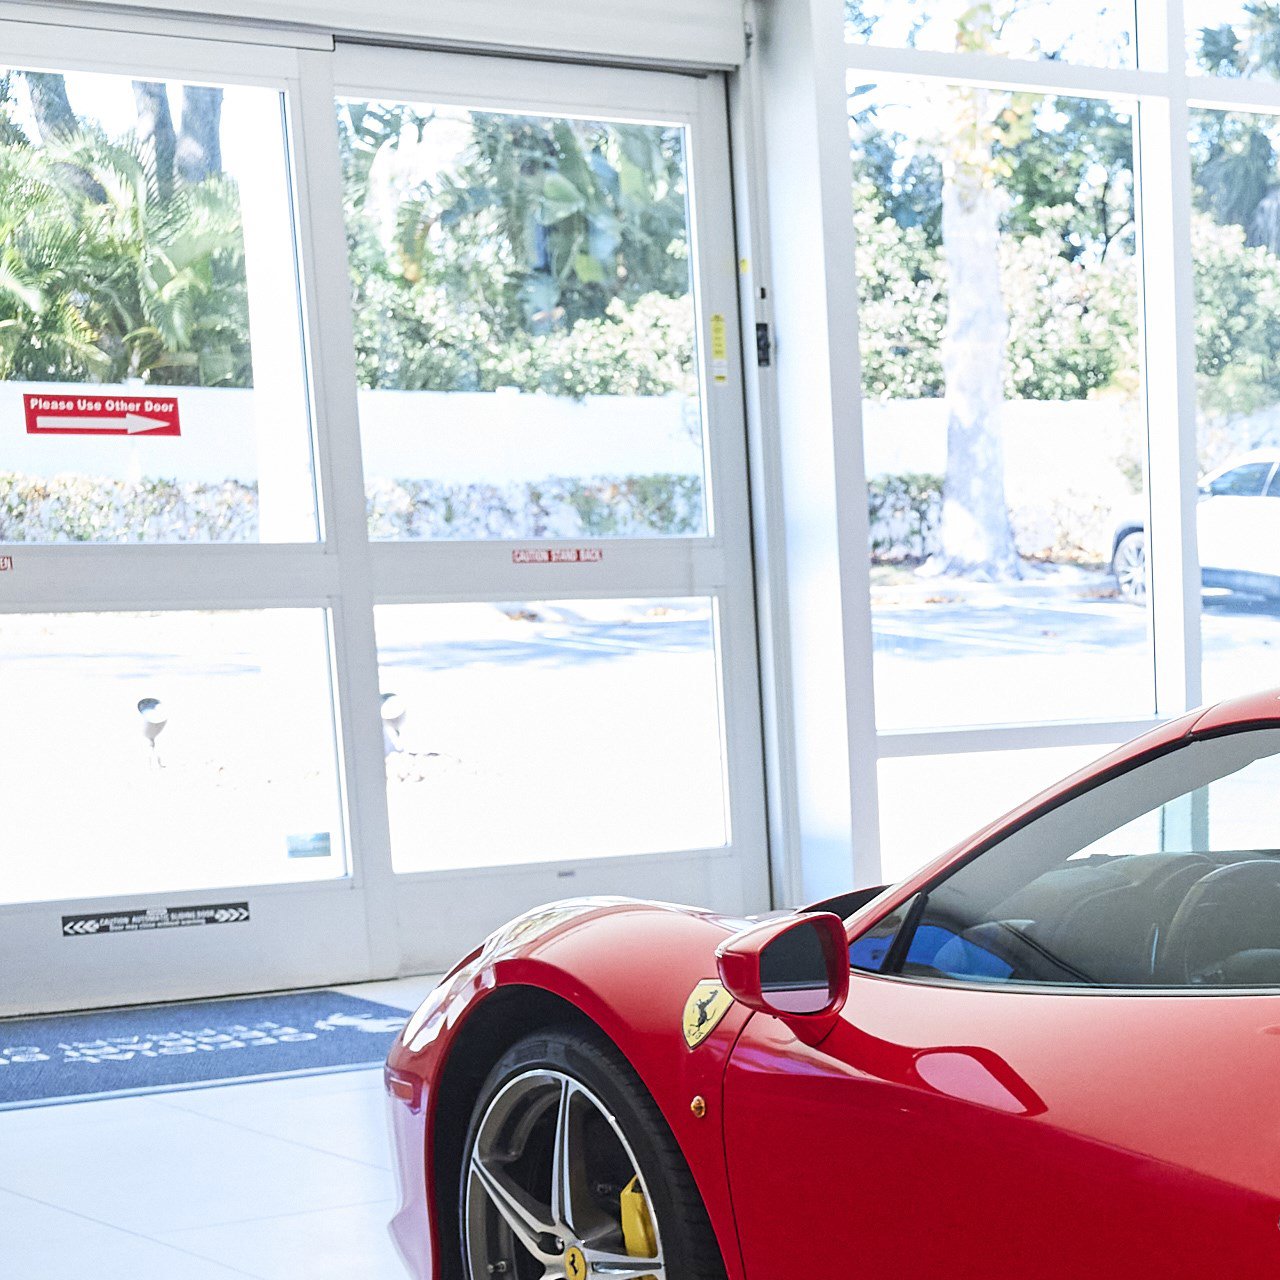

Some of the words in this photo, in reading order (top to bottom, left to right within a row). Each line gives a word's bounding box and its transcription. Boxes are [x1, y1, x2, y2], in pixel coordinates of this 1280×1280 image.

[30, 398, 74, 410] Please
[77, 399, 101, 411] Use
[105, 400, 140, 411] Other
[144, 401, 174, 412] Door
